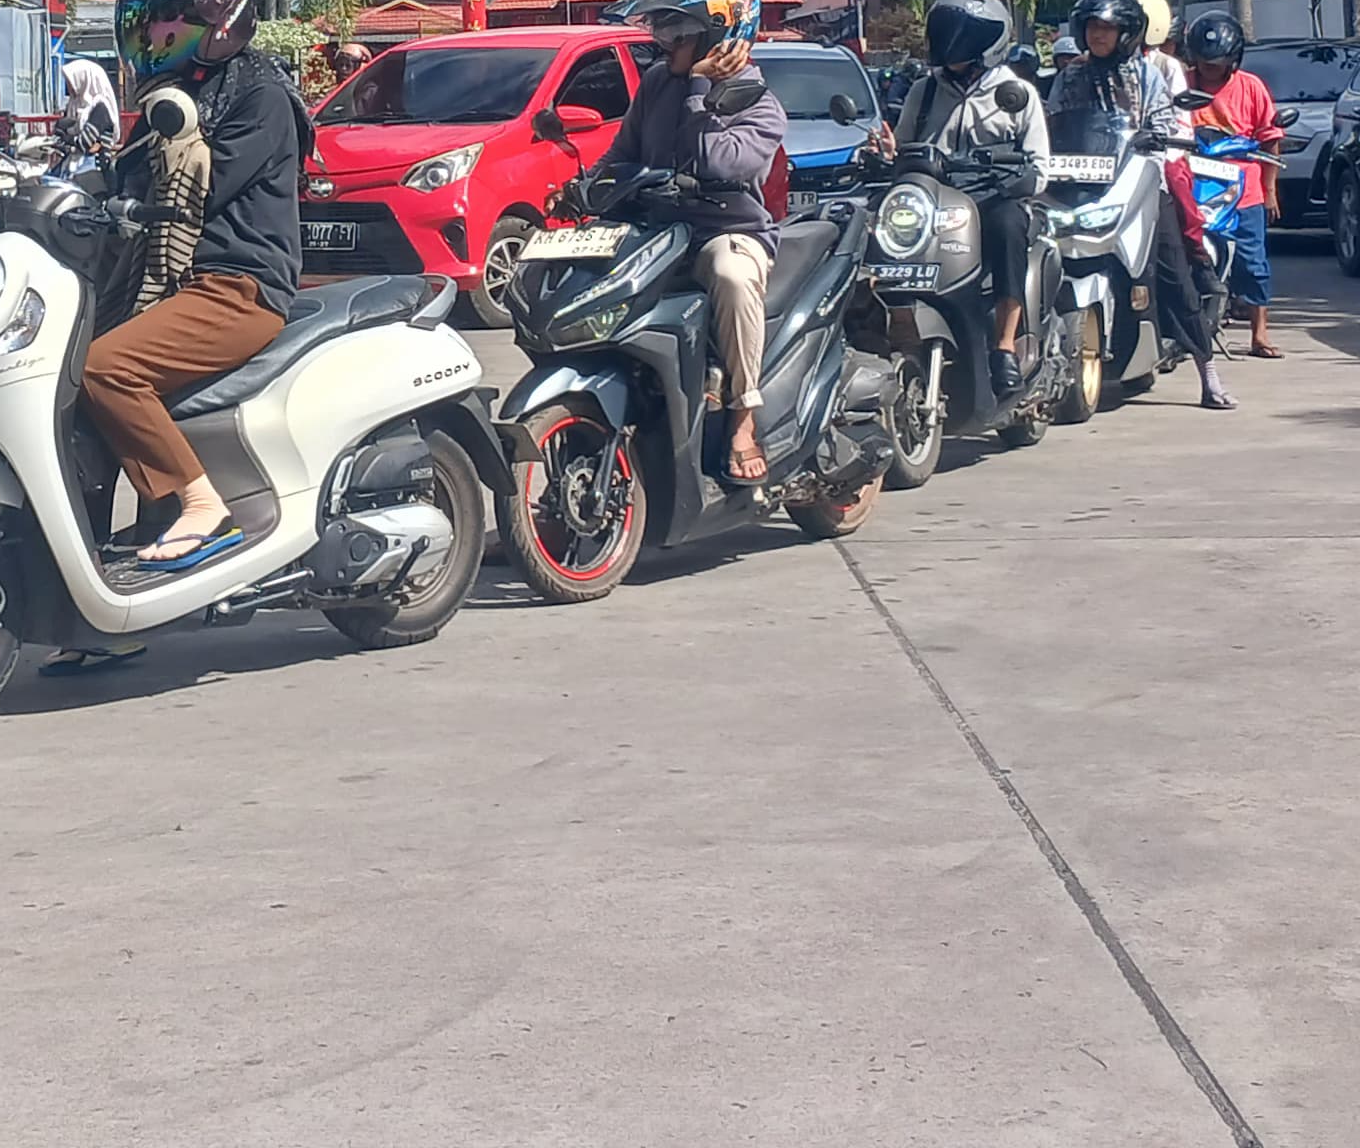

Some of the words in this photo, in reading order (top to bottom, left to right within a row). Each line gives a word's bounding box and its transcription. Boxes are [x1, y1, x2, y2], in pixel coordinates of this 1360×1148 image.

[801, 193, 815, 204] FR
[879, 266, 913, 278] 3229
[916, 266, 936, 278] LU
[413, 362, 470, 387] SCOOPY
